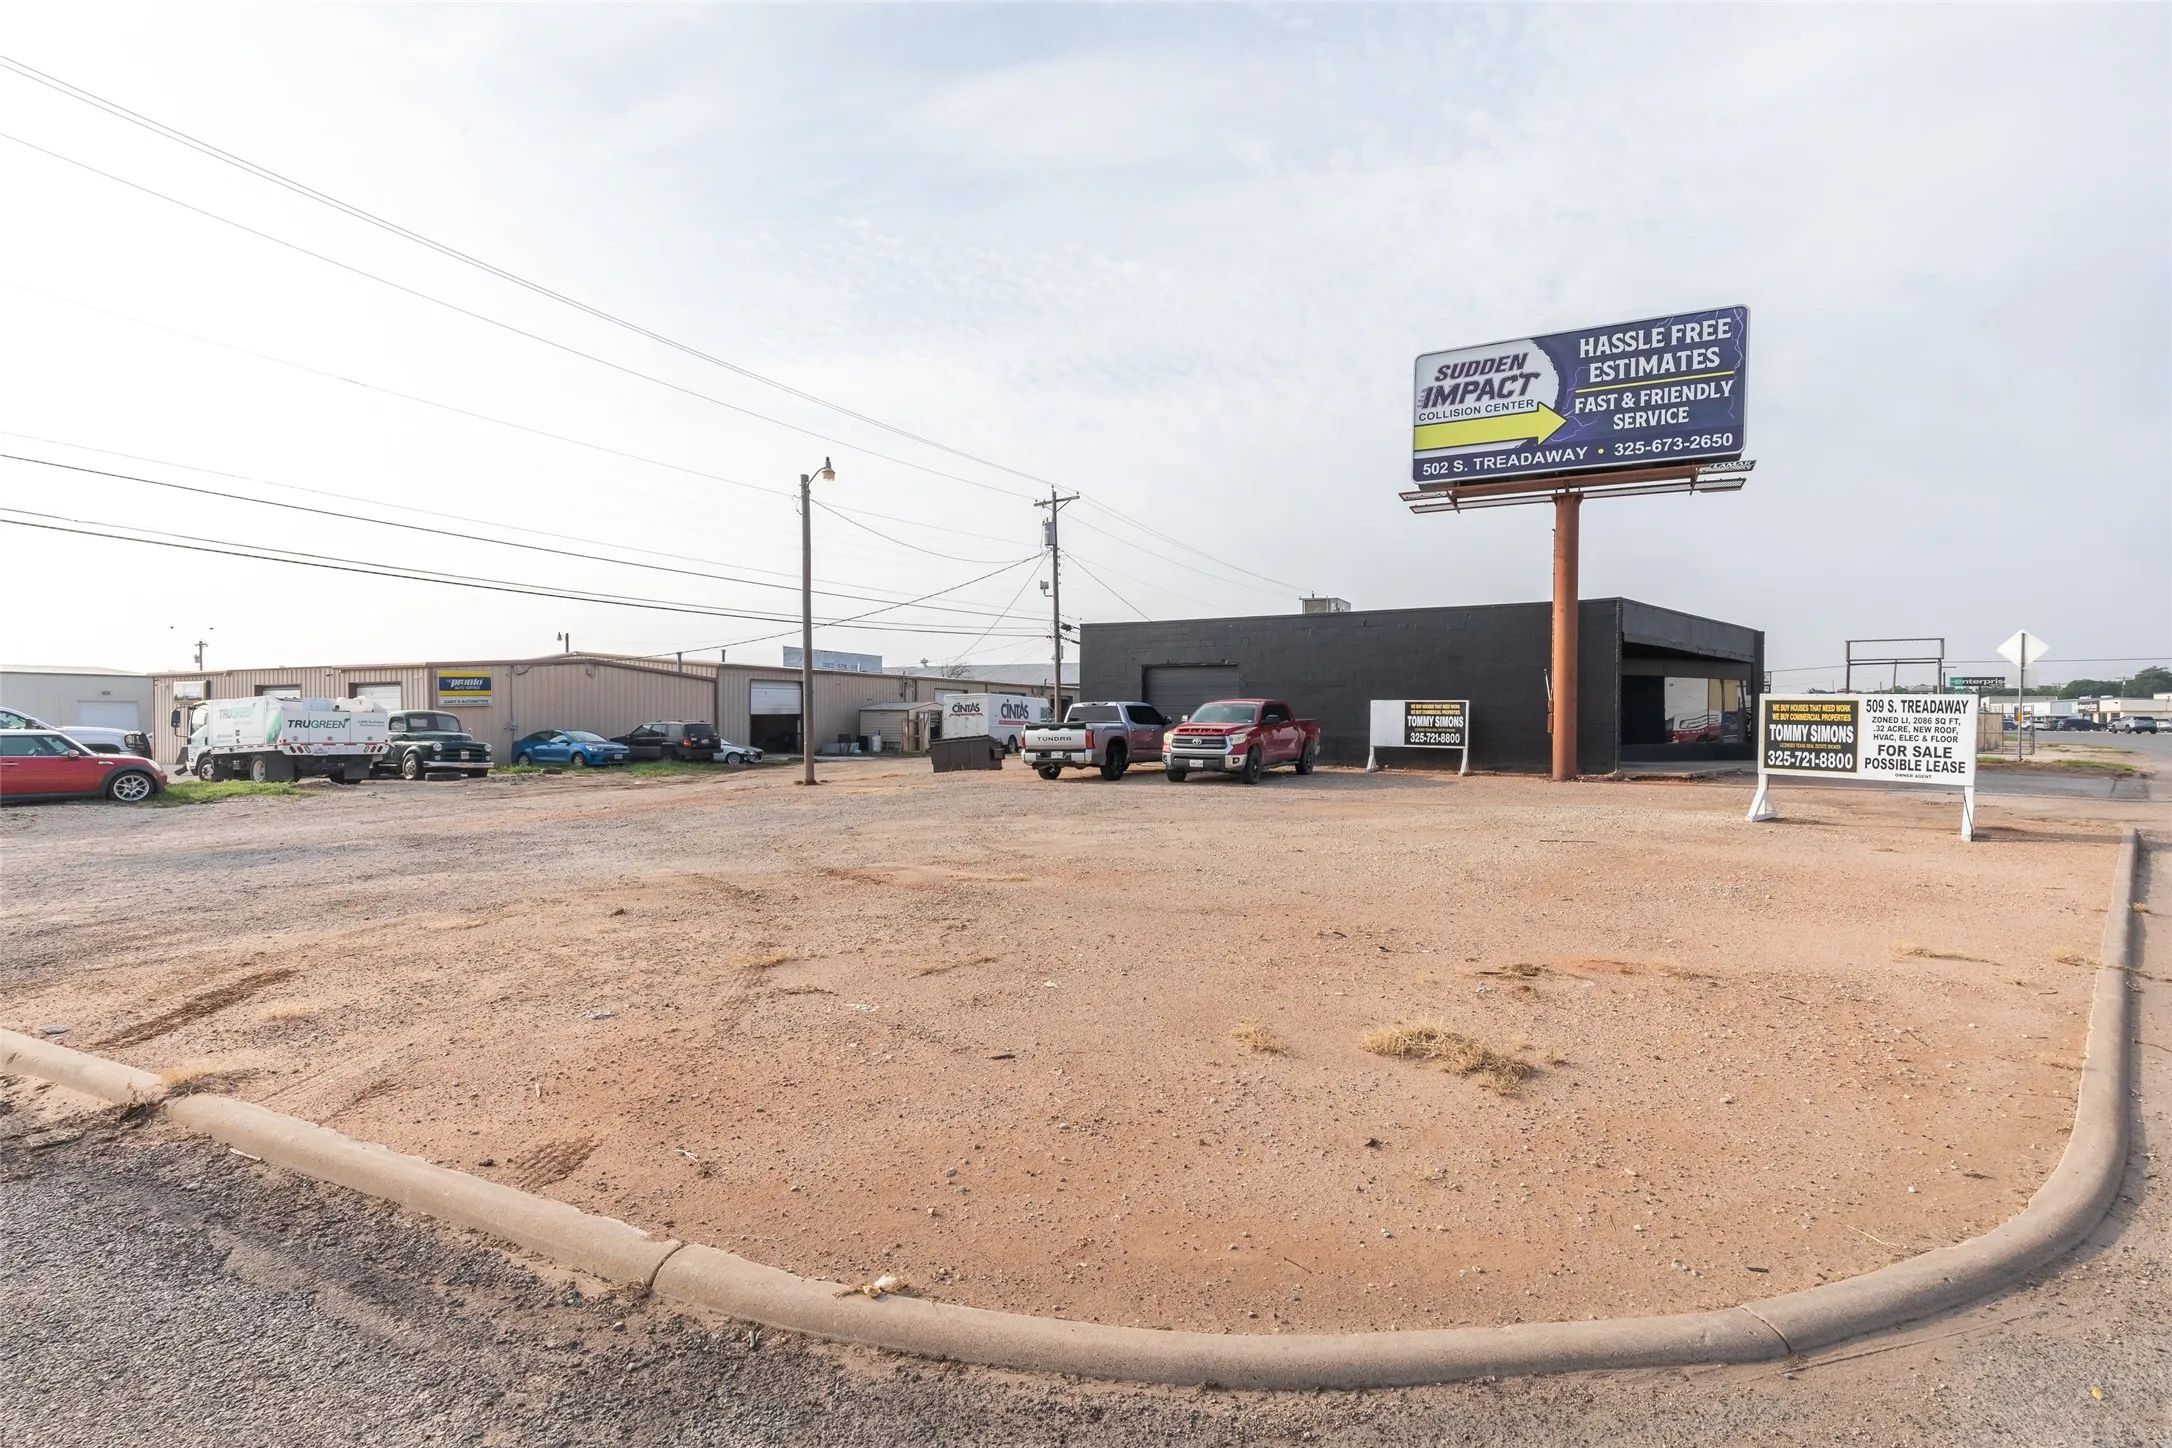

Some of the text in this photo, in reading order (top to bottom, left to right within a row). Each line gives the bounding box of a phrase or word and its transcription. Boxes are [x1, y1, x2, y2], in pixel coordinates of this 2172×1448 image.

[1579, 318, 1732, 358] HASSLE FREE
[1434, 352, 1529, 382] SUDDEN
[1589, 347, 1721, 383] ESTIMATES
[1420, 371, 1542, 409] IMPACT
[1575, 380, 1734, 414] FAST & FRIENDLY
[1418, 399, 1534, 422] COLLISION CENTER
[1613, 407, 1689, 430] SERVICE
[1423, 432, 1733, 475] 502 S. TREADAWAY 325-673-2650
[450, 678, 483, 688] pronto
[1790, 704, 1809, 712] HOUSES
[1866, 699, 1969, 714] 509 S. TREADAWAY
[288, 719, 346, 728] TRUGREEN
[1407, 716, 1464, 727] TOMMY SIMONS
[1790, 713, 1820, 721] COMMERCIAL
[1913, 717, 1932, 725] 2086
[1949, 718, 1961, 726] FT,
[1769, 724, 1854, 743] TOMMY SIMONS
[1887, 725, 1911, 734] ACRE,
[1934, 726, 1959, 735] ROOF,
[1410, 733, 1460, 743] 325-721-8800
[1873, 734, 1897, 742] HVAC,
[1768, 750, 1853, 769] 325-721-8800
[1878, 745, 1952, 759] FOR SALE
[1865, 758, 1966, 774] POSSIBLE LEASE
